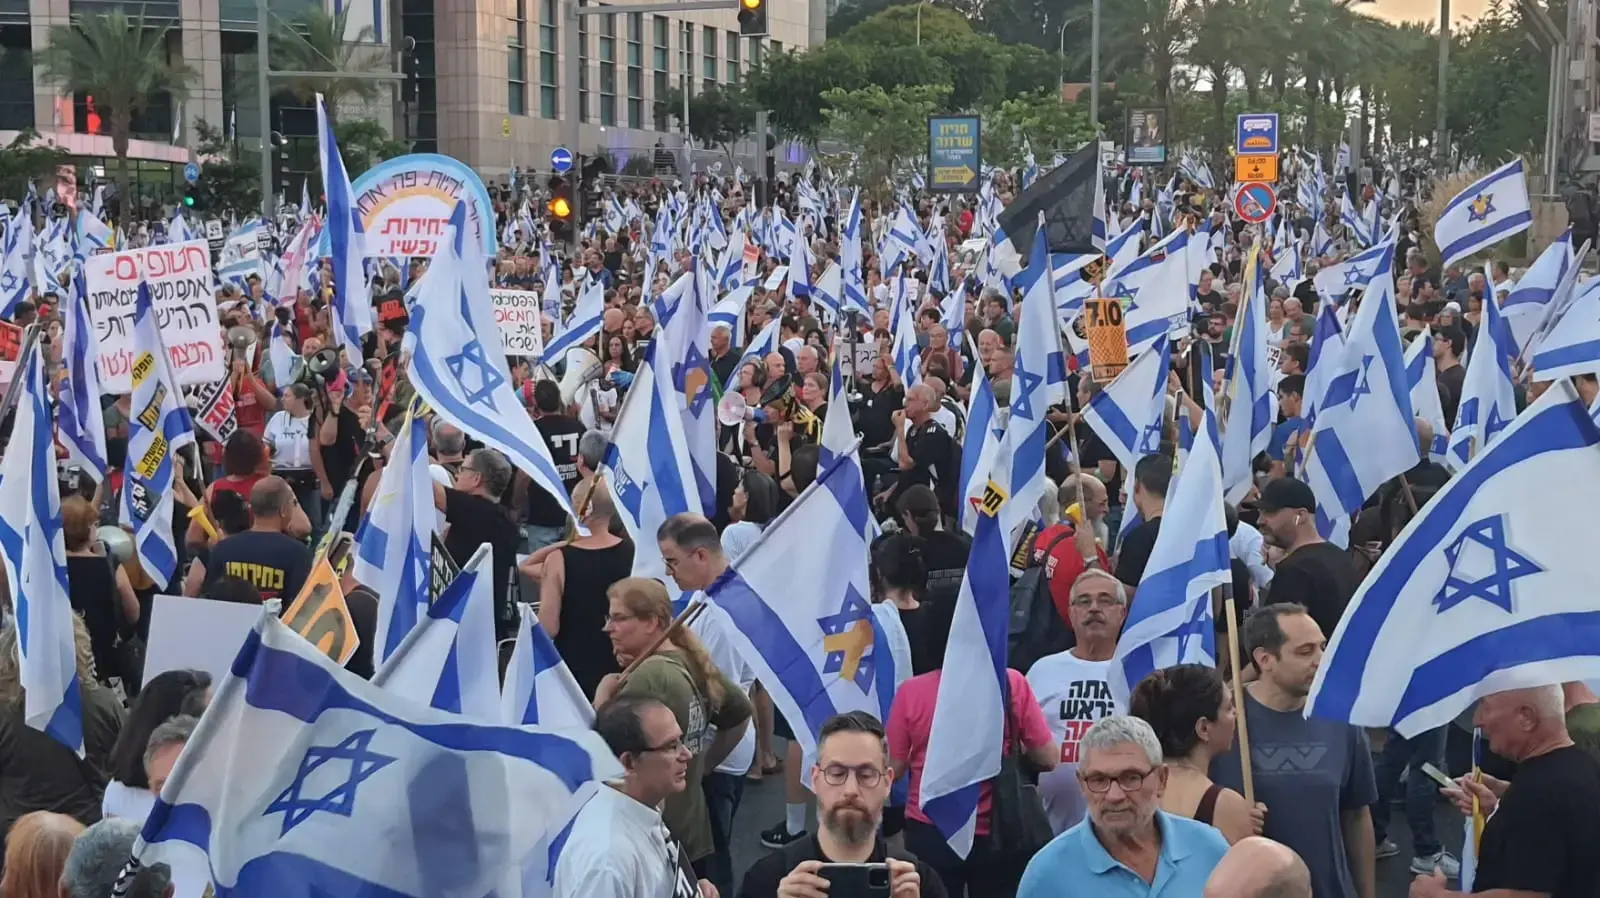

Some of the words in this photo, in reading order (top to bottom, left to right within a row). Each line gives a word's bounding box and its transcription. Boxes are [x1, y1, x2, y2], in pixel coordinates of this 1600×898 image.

[391, 171, 417, 190] פה
[177, 276, 211, 301] אתם
[1085, 300, 1122, 327] 7.10
[500, 332, 537, 352] ישרא
